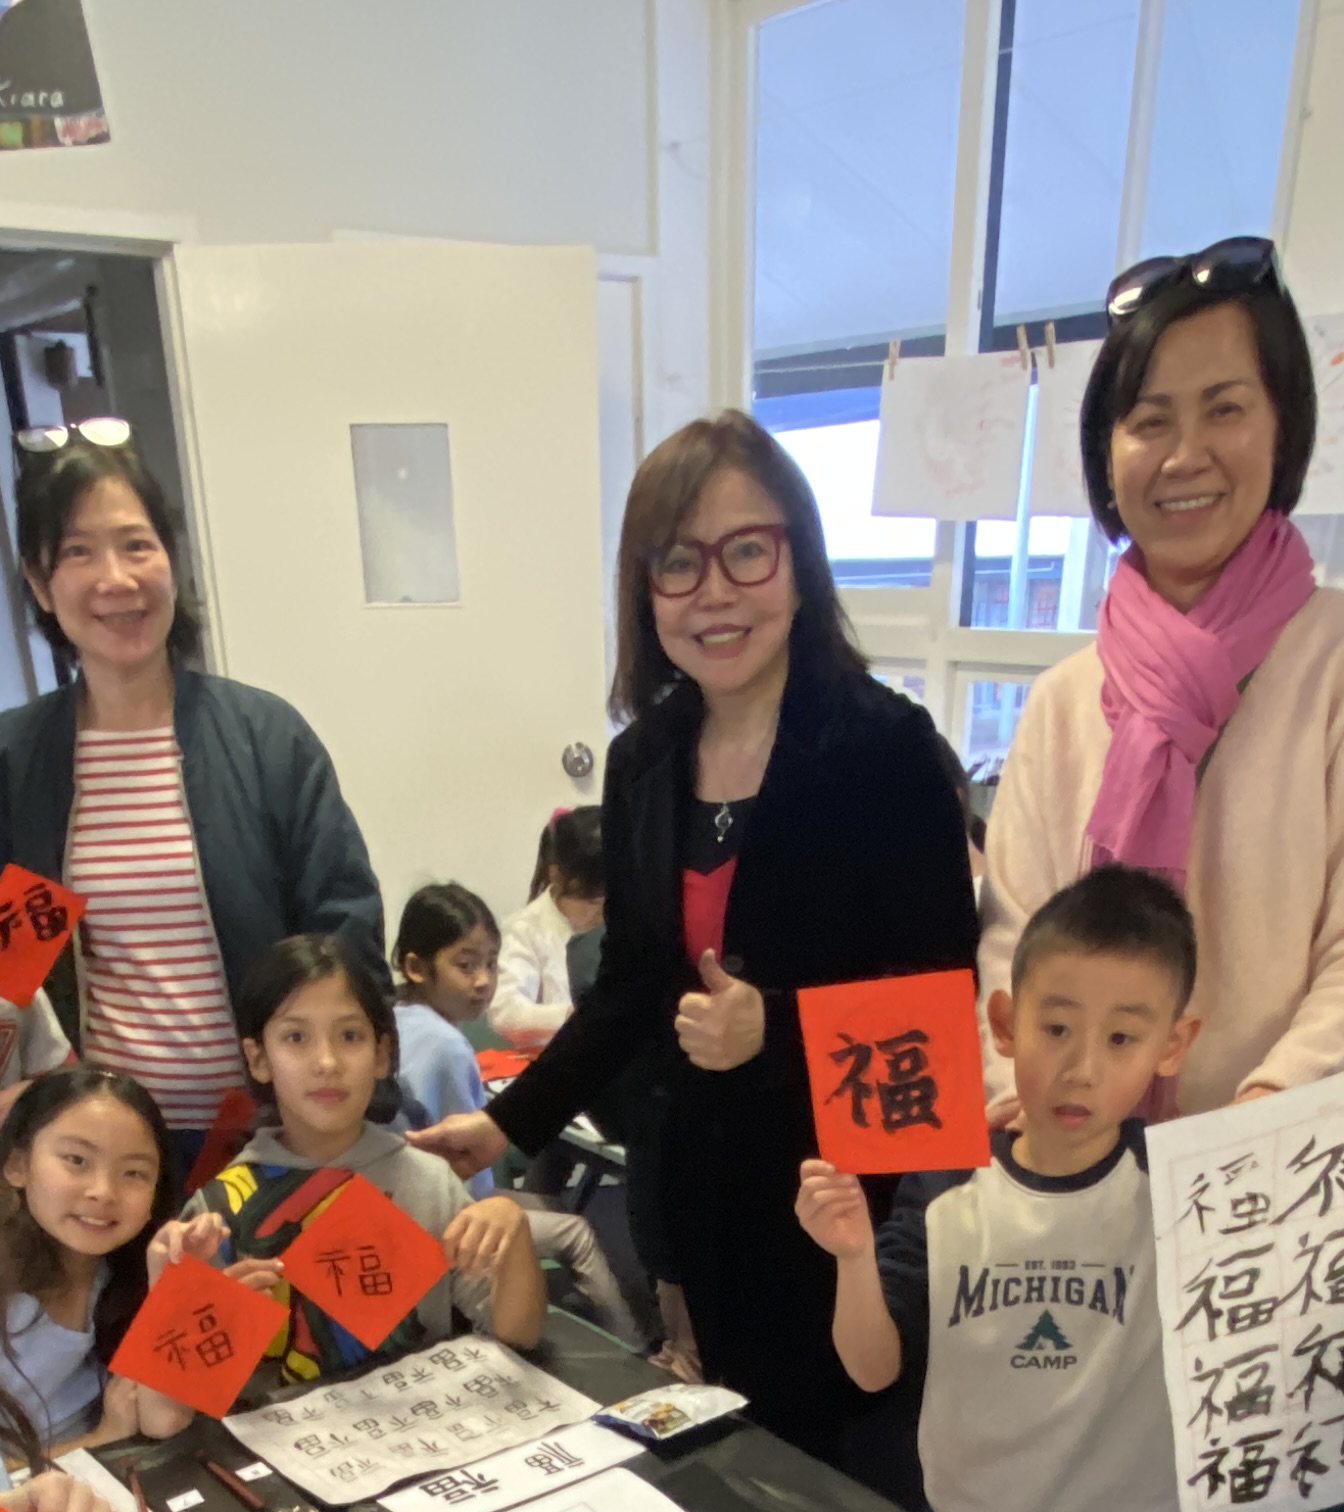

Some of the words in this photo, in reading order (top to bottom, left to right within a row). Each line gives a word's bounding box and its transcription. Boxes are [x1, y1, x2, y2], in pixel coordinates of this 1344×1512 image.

[823, 1028, 943, 1136] 福
[315, 1244, 393, 1298] 福
[1174, 1241, 1280, 1342] 福
[153, 1302, 235, 1371] 福
[1009, 1354, 1079, 1370] CAMP
[1186, 1343, 1280, 1441] 福
[417, 1465, 501, 1507] 福
[1186, 1428, 1284, 1505] 福
